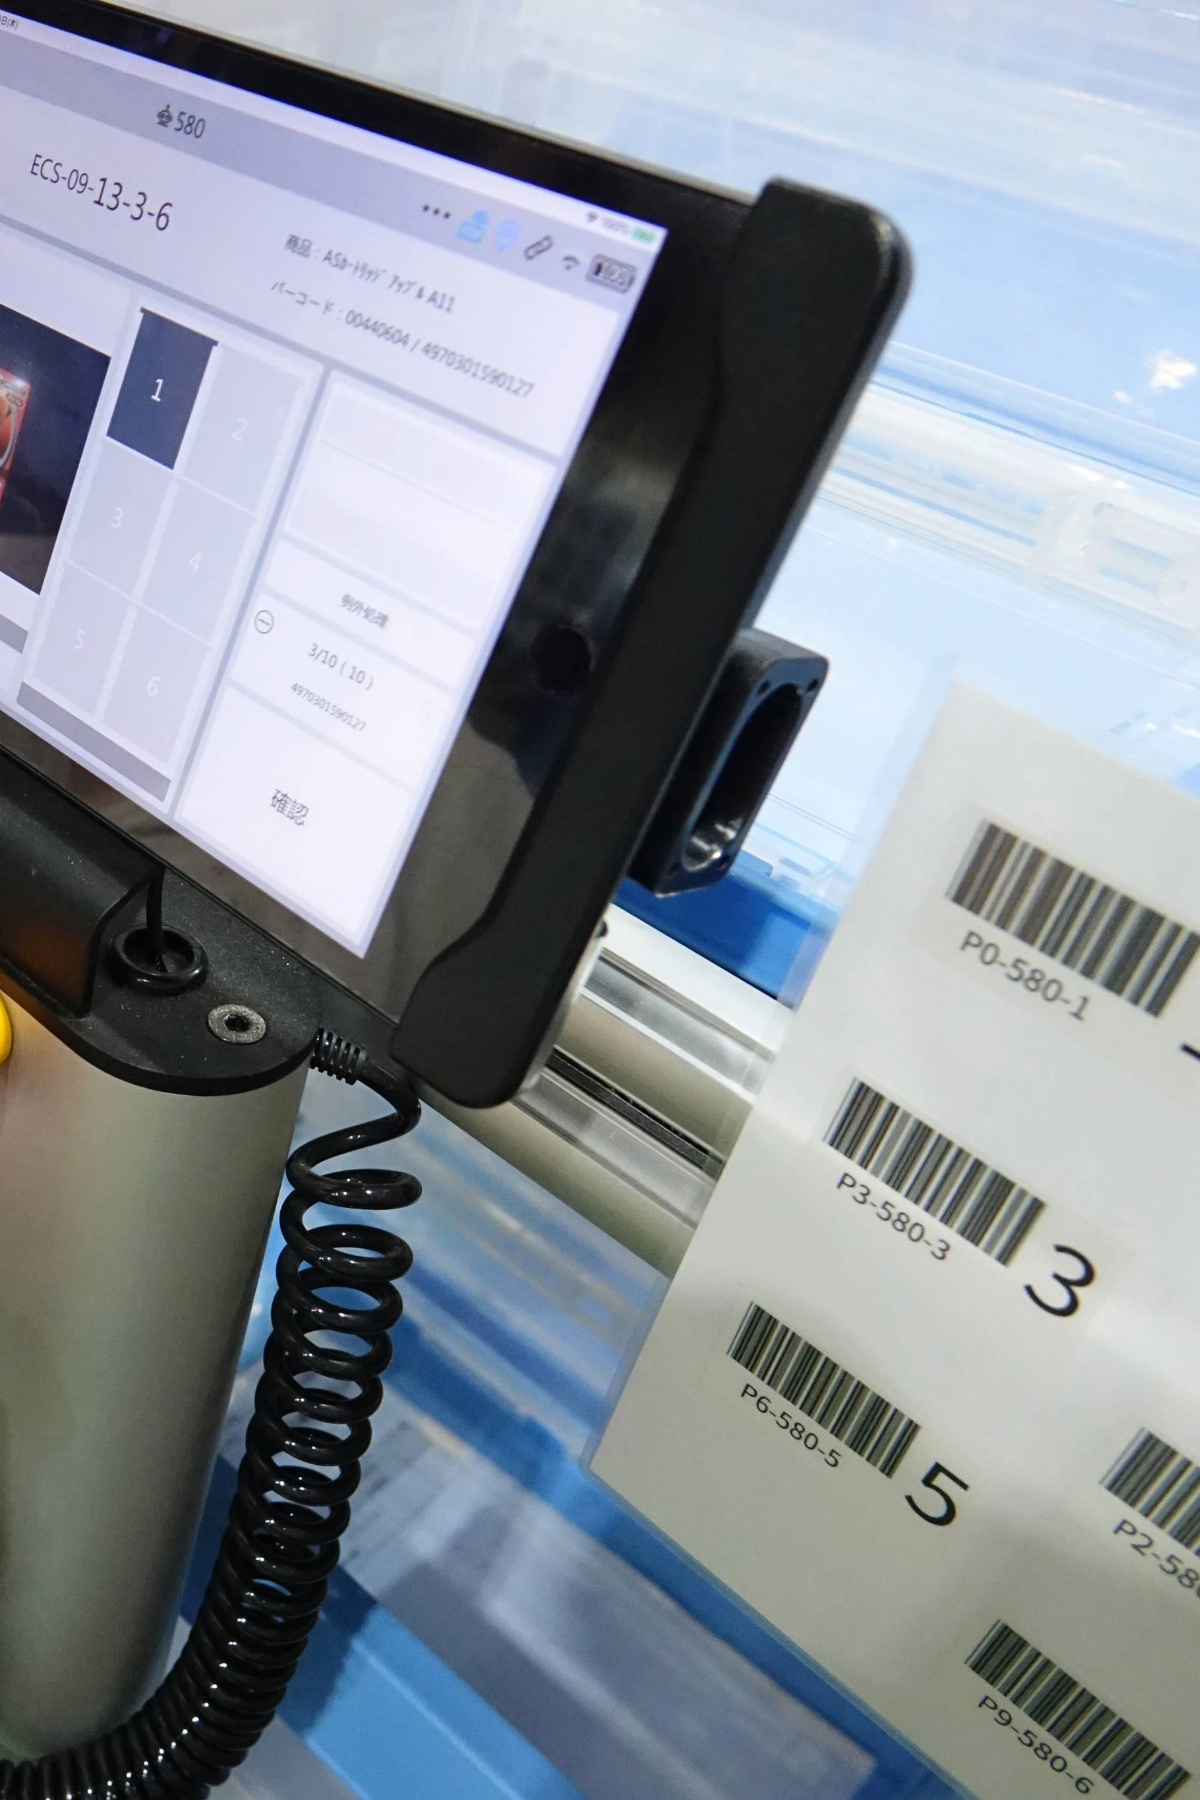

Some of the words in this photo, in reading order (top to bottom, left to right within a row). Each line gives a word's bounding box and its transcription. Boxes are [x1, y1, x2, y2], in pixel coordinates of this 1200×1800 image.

[174, 111, 206, 139] 580
[30, 154, 173, 231] ECS-09-13-3-6
[345, 309, 410, 349] 00440604
[150, 378, 164, 402] 1
[231, 418, 248, 442] 2
[111, 507, 125, 530] 3
[188, 551, 203, 574] 4
[73, 628, 86, 650] 5
[308, 642, 338, 669] 3/10
[147, 676, 161, 697] 6
[270, 789, 309, 826] 確認
[960, 930, 1091, 1022] P0-580-1
[835, 1171, 951, 1261] P3-580-3
[1023, 1243, 1096, 1318] 3
[740, 1383, 843, 1468] P6-580-5
[904, 1461, 970, 1526] 5
[1113, 1518, 1200, 1599] P2-58
[977, 1694, 1095, 1795] P9-580-6
